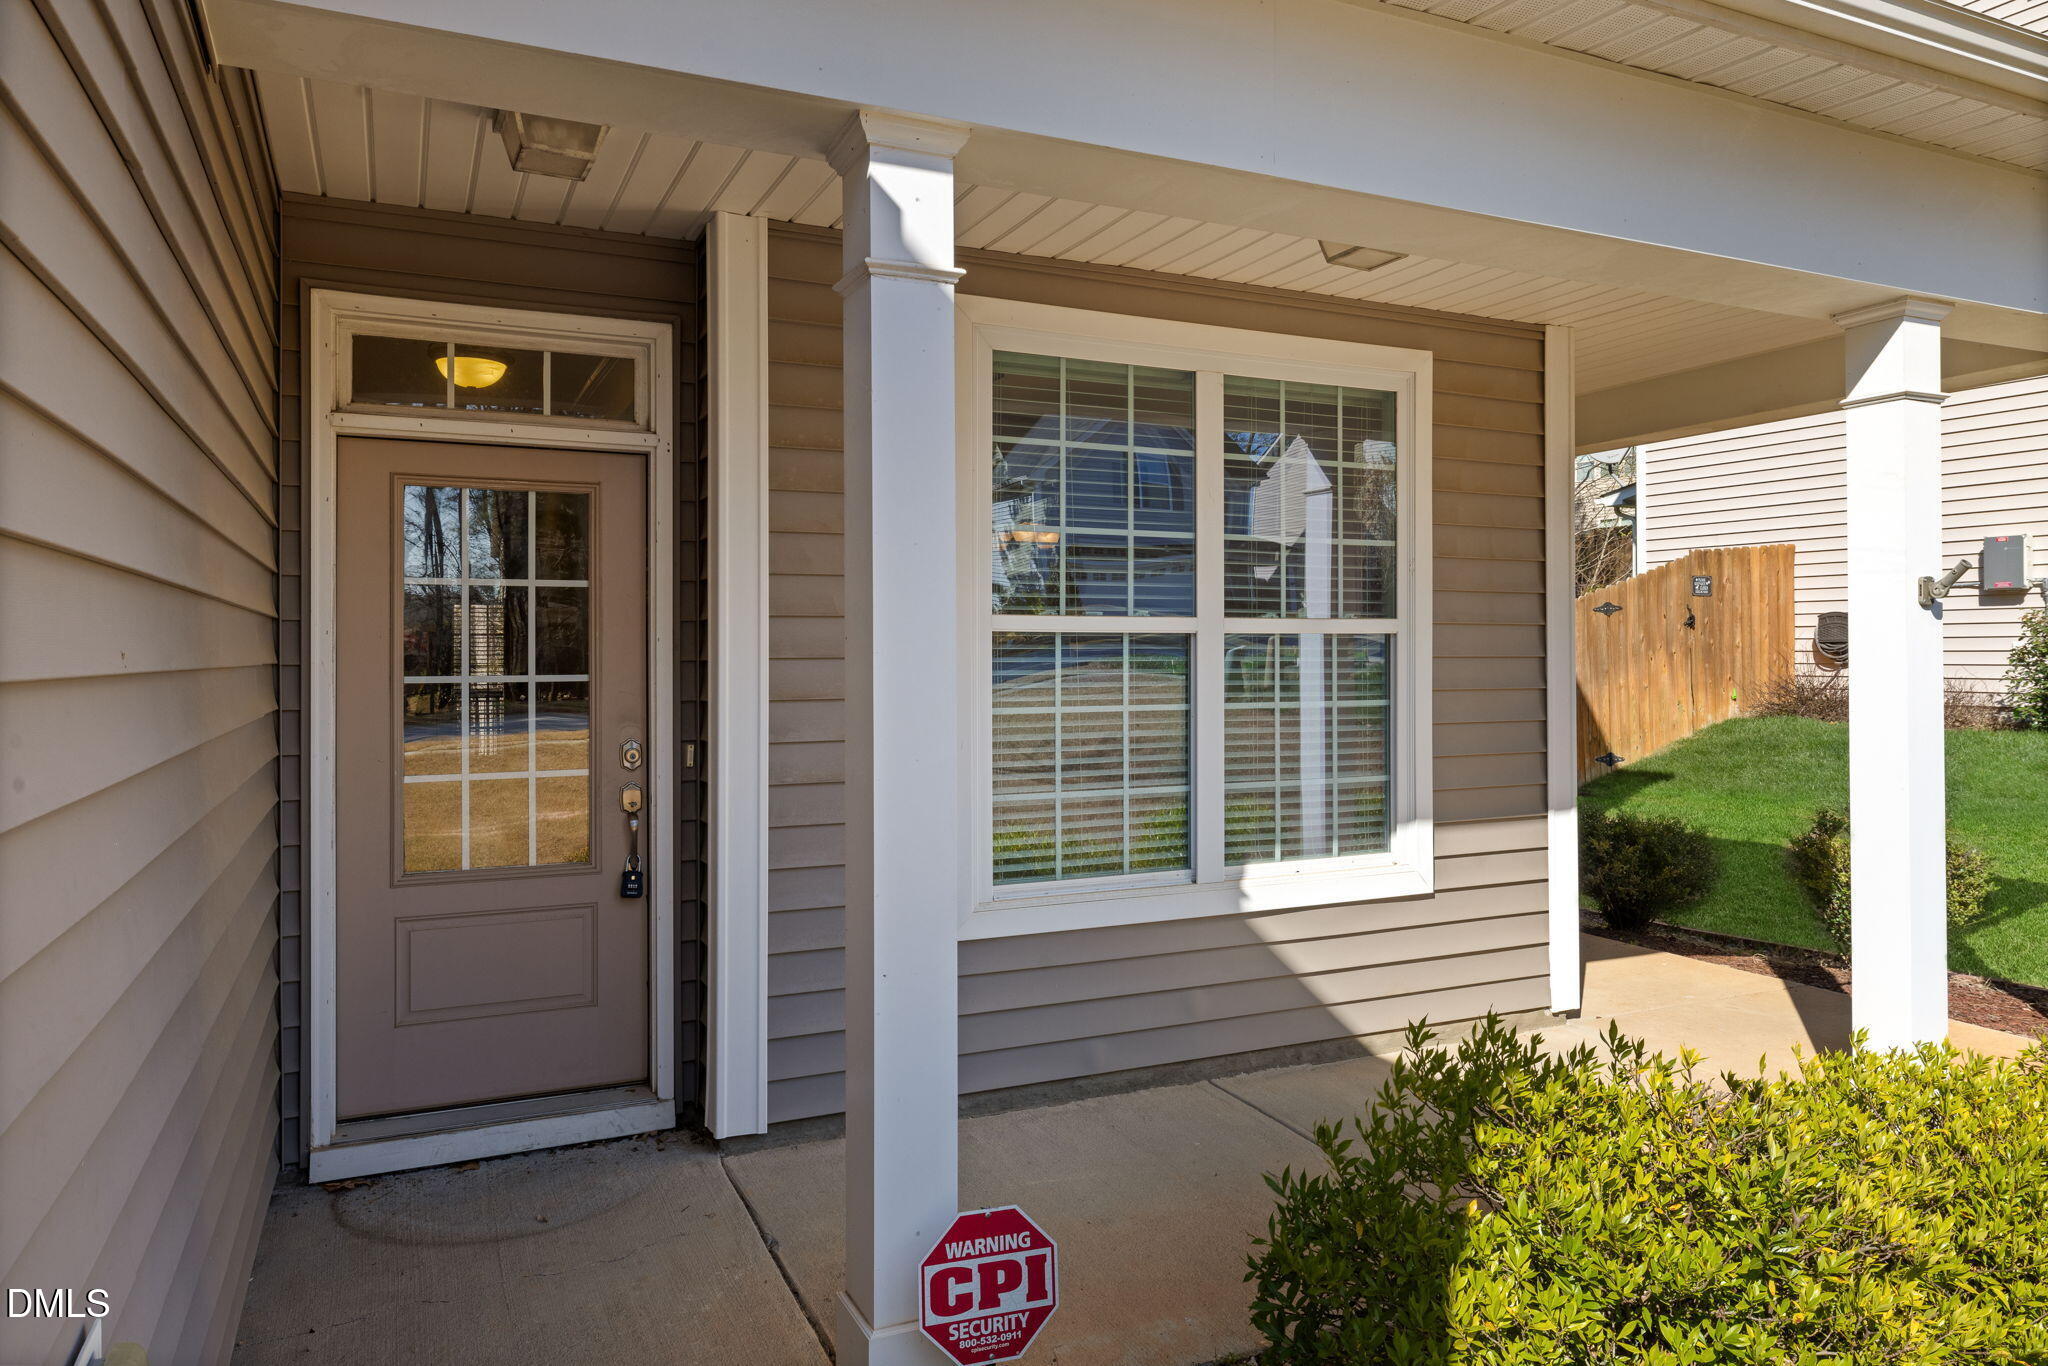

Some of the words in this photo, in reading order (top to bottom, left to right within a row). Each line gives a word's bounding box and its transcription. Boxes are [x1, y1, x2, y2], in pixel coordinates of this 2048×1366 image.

[945, 1231, 1031, 1259] WARNING
[930, 1254, 1048, 1317] CPI
[949, 1312, 1030, 1341] SECURITY
[959, 1331, 1022, 1349] 800-532-0911
